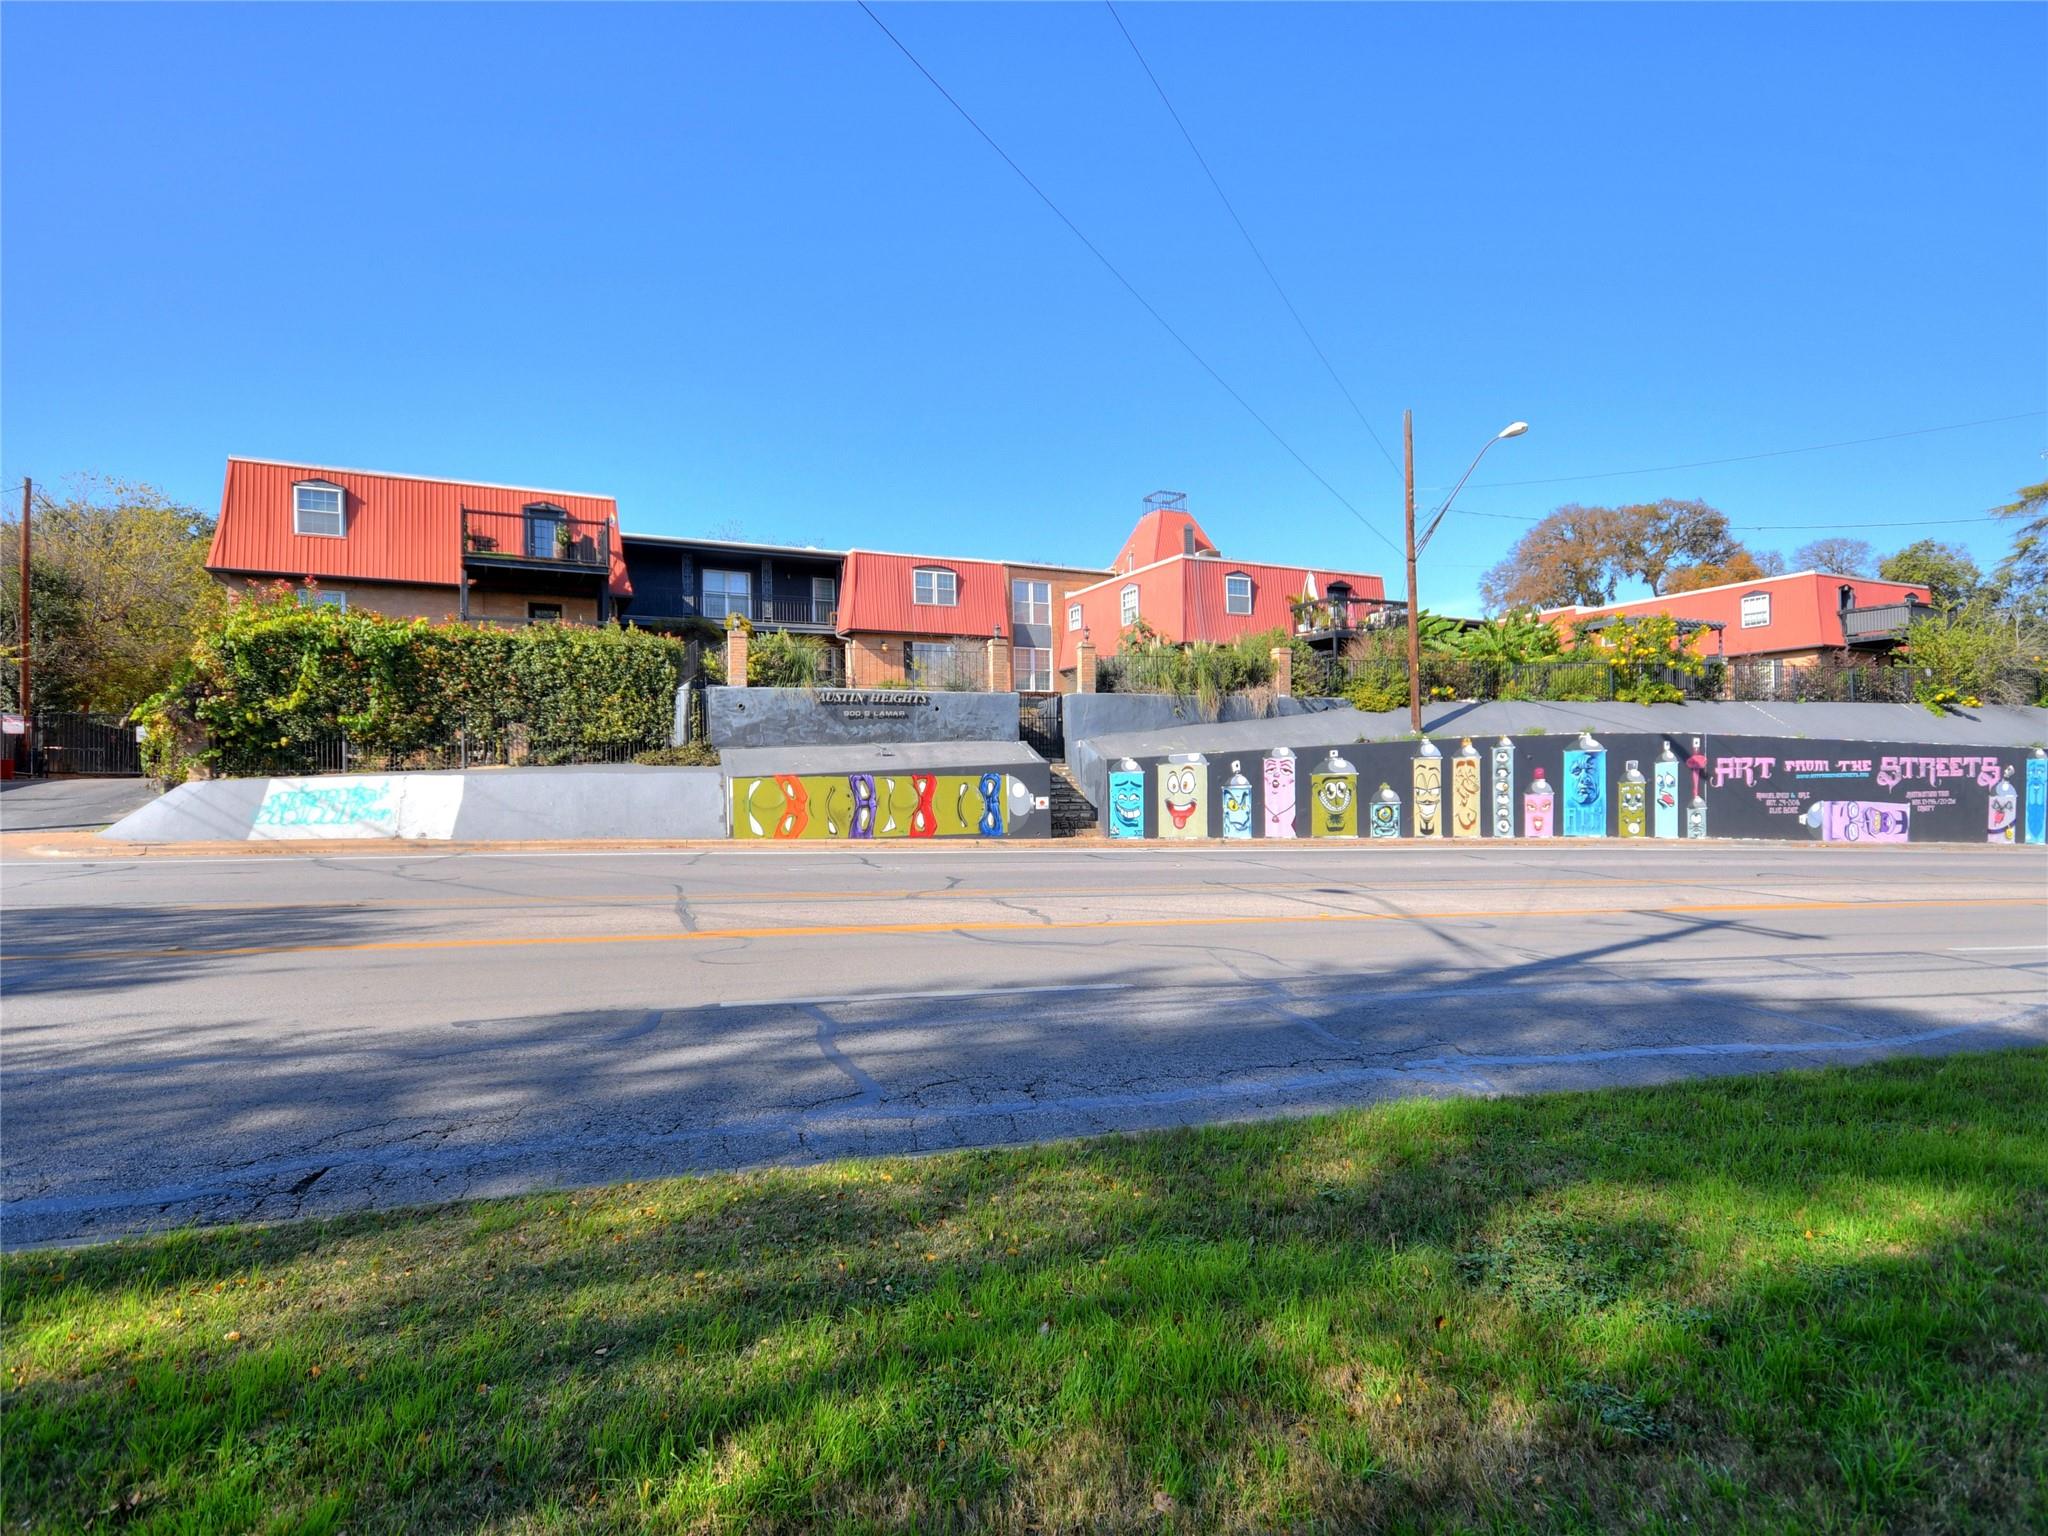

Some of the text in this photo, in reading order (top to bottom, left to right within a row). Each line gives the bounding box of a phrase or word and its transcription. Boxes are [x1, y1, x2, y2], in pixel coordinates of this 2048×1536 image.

[819, 692, 928, 704] AUSTIN HEIGHTS
[1710, 756, 2001, 794] ART FROM THE STREETS
